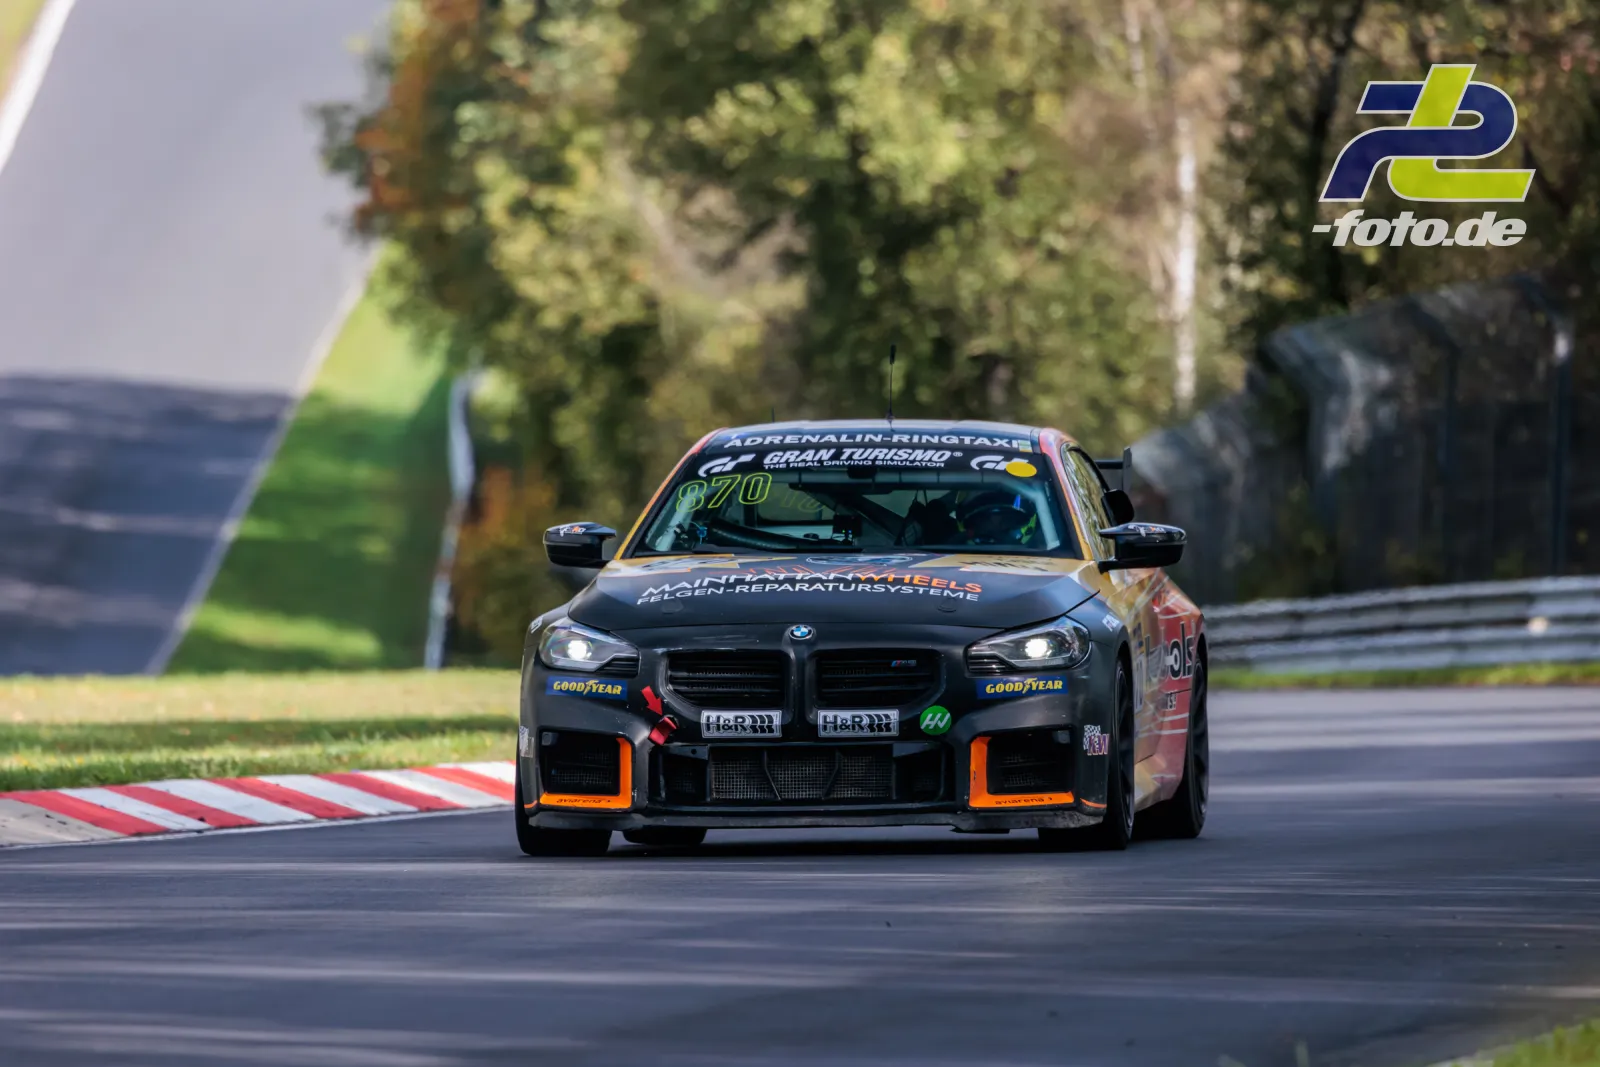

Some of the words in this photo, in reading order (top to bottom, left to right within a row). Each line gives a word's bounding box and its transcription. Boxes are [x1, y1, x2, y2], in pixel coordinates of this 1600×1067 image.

[763, 448, 836, 465] GRAN
[789, 460, 821, 468] REAL
[823, 458, 872, 466] DRIVING
[875, 460, 946, 468] SIMULATOR
[676, 472, 773, 513] 870
[636, 582, 980, 606] FELGEN-REPARATURSYSTEME
